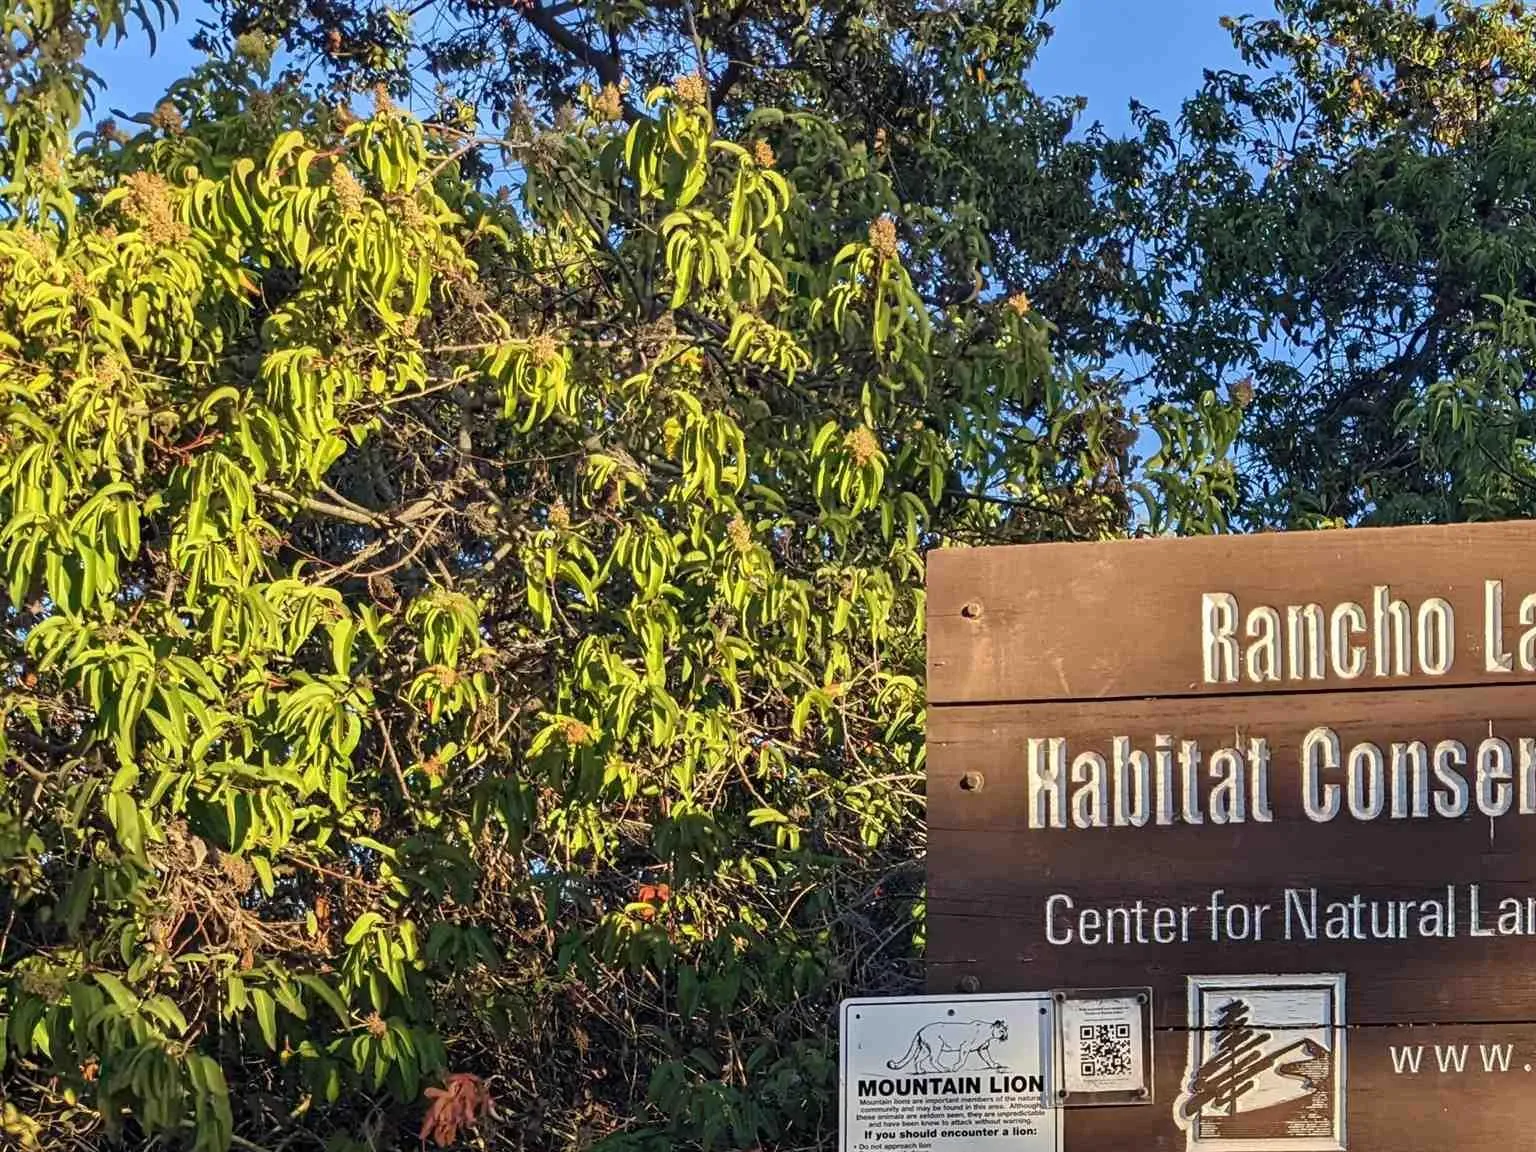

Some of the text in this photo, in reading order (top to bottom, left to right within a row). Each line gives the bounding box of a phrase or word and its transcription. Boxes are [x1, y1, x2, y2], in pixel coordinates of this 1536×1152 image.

[1202, 583, 1454, 684] Rancho
[1028, 733, 1273, 830] Habitat
[1044, 891, 1196, 948] Center
[1208, 887, 1266, 941] for
[1284, 884, 1457, 941] Natural
[858, 1075, 1044, 1097] MOUNTAIN LION
[865, 1130, 872, 1139] If
[876, 1131, 895, 1140] you
[900, 1129, 937, 1138] should
[941, 1128, 999, 1137] encounter
[1013, 1126, 1038, 1136] lion:
